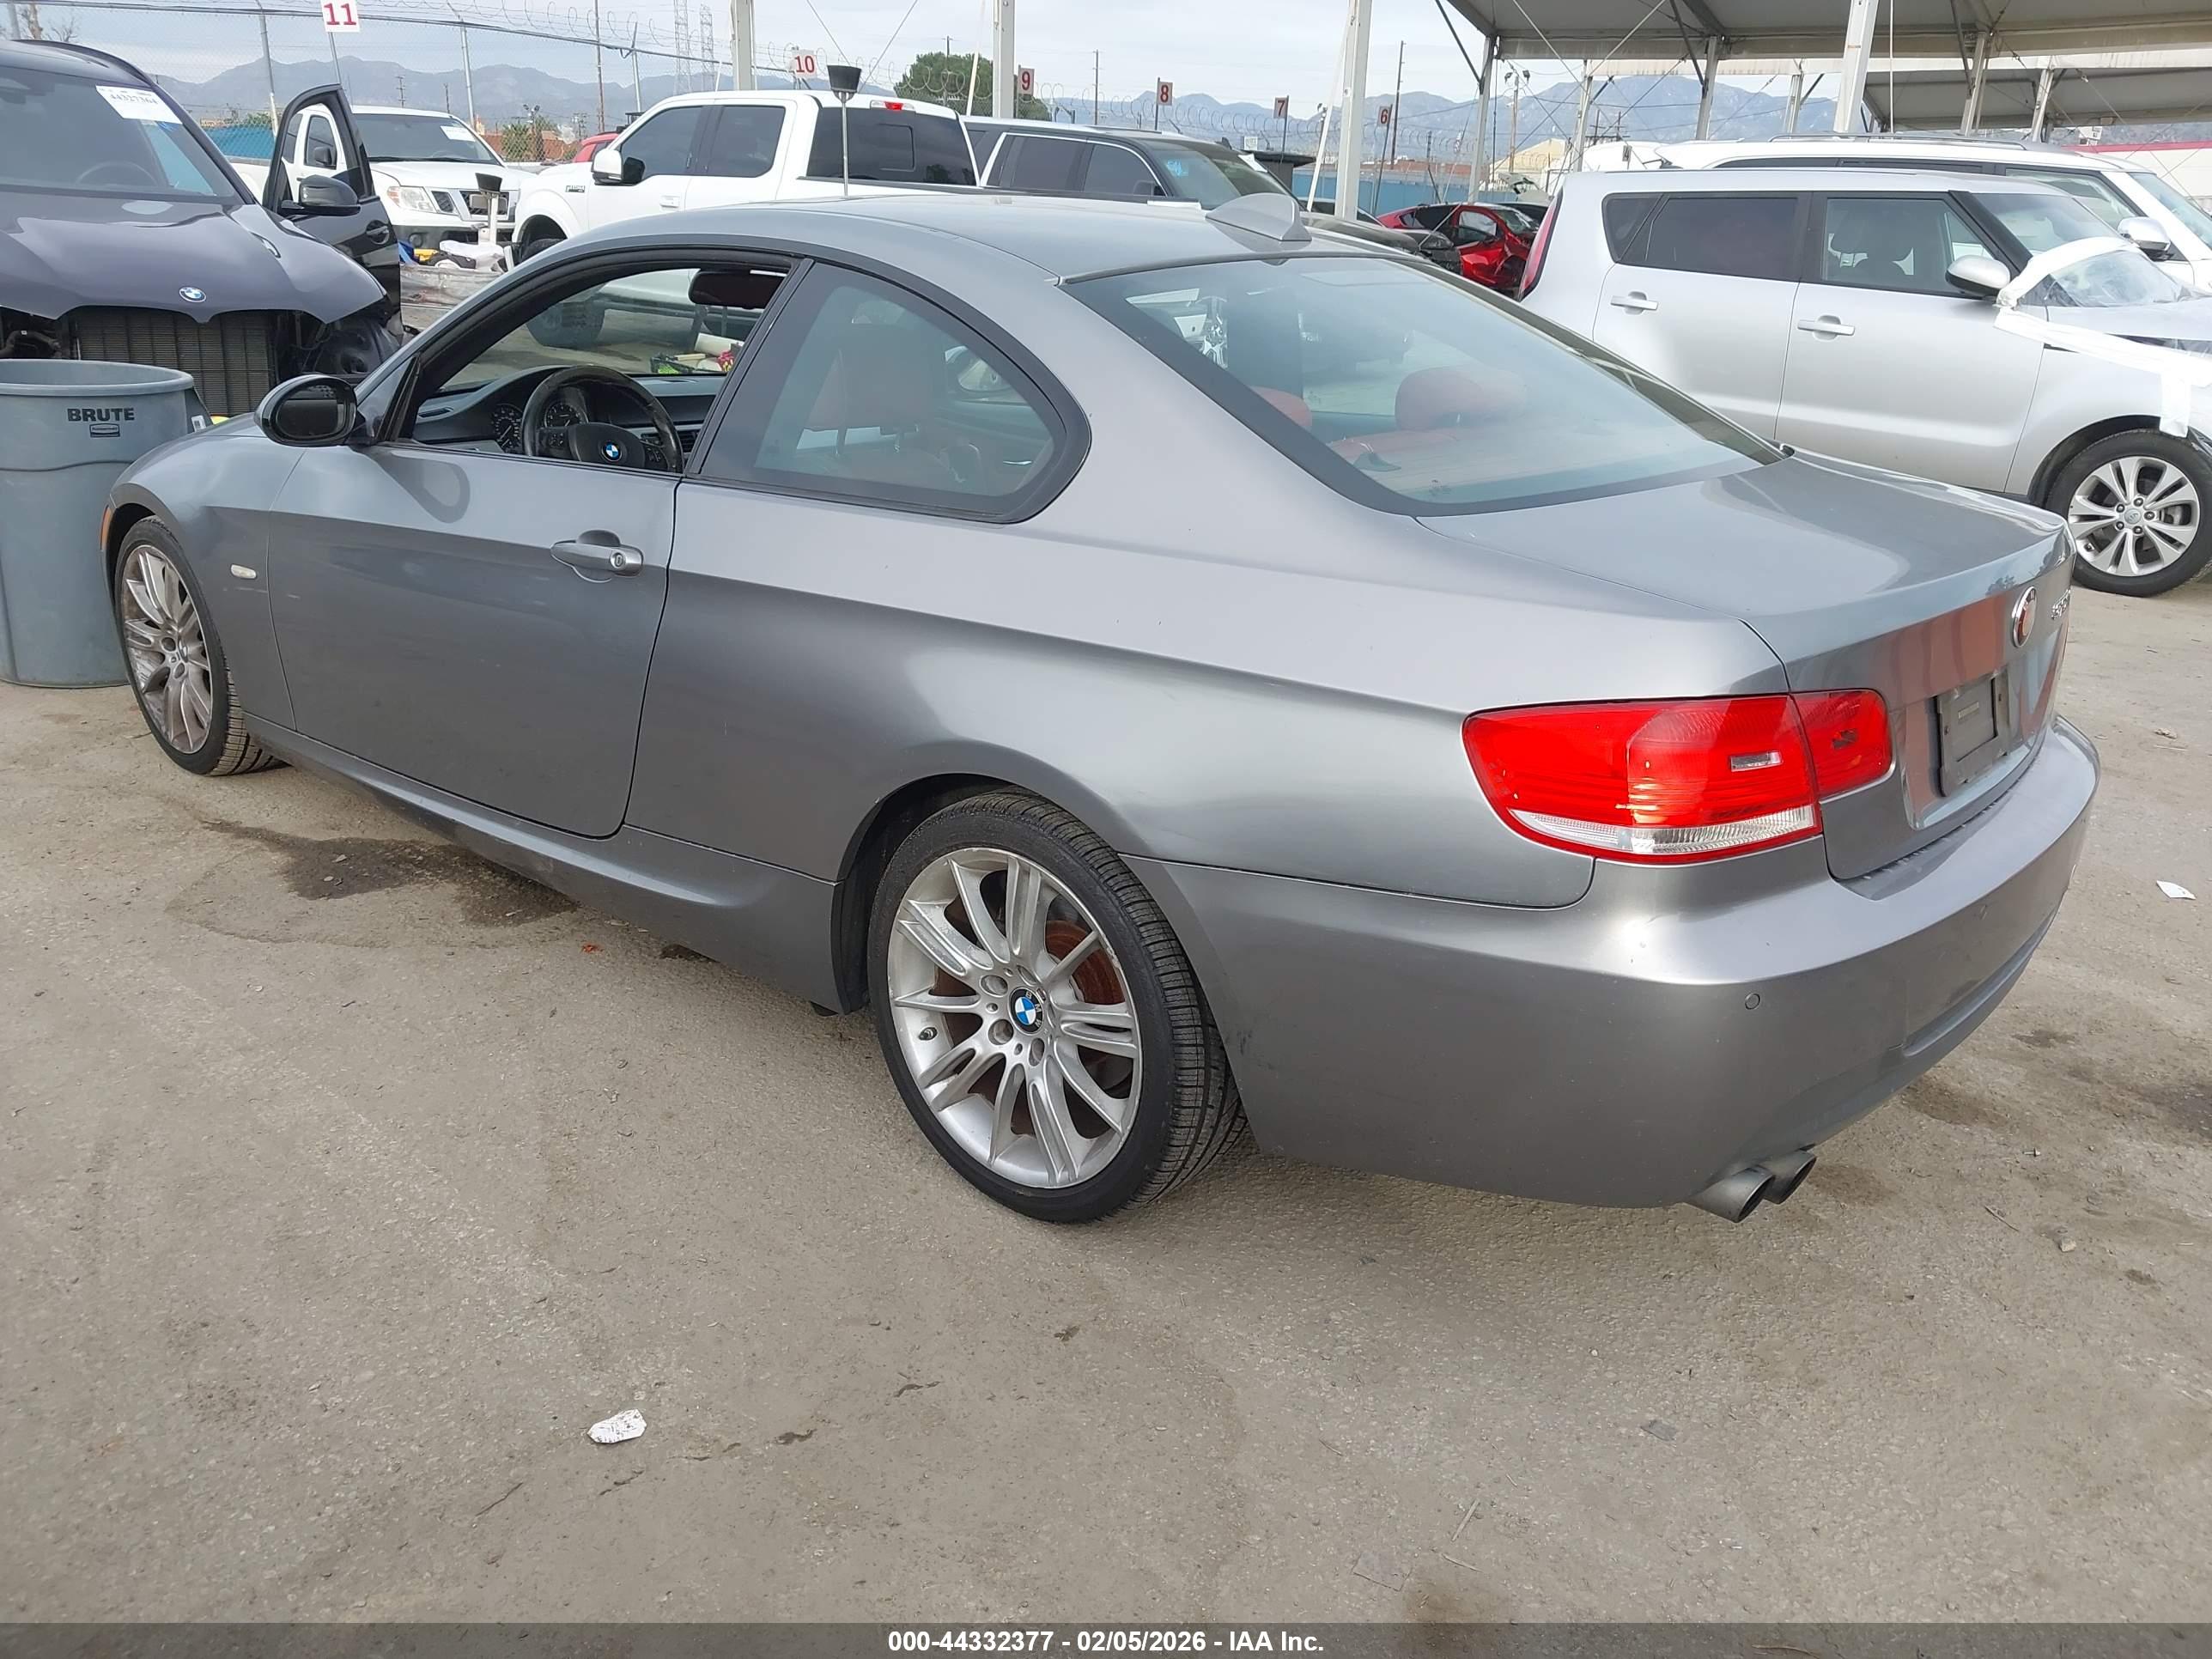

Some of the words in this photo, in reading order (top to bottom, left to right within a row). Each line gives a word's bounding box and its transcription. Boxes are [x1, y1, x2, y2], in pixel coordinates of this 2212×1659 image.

[324, 3, 356, 26] 11
[794, 55, 815, 73] 10
[1022, 70, 1030, 91] 9
[1160, 84, 1169, 103] 8
[1277, 100, 1285, 117] 7
[1380, 108, 1389, 125] 6
[67, 408, 135, 422] BRUTE
